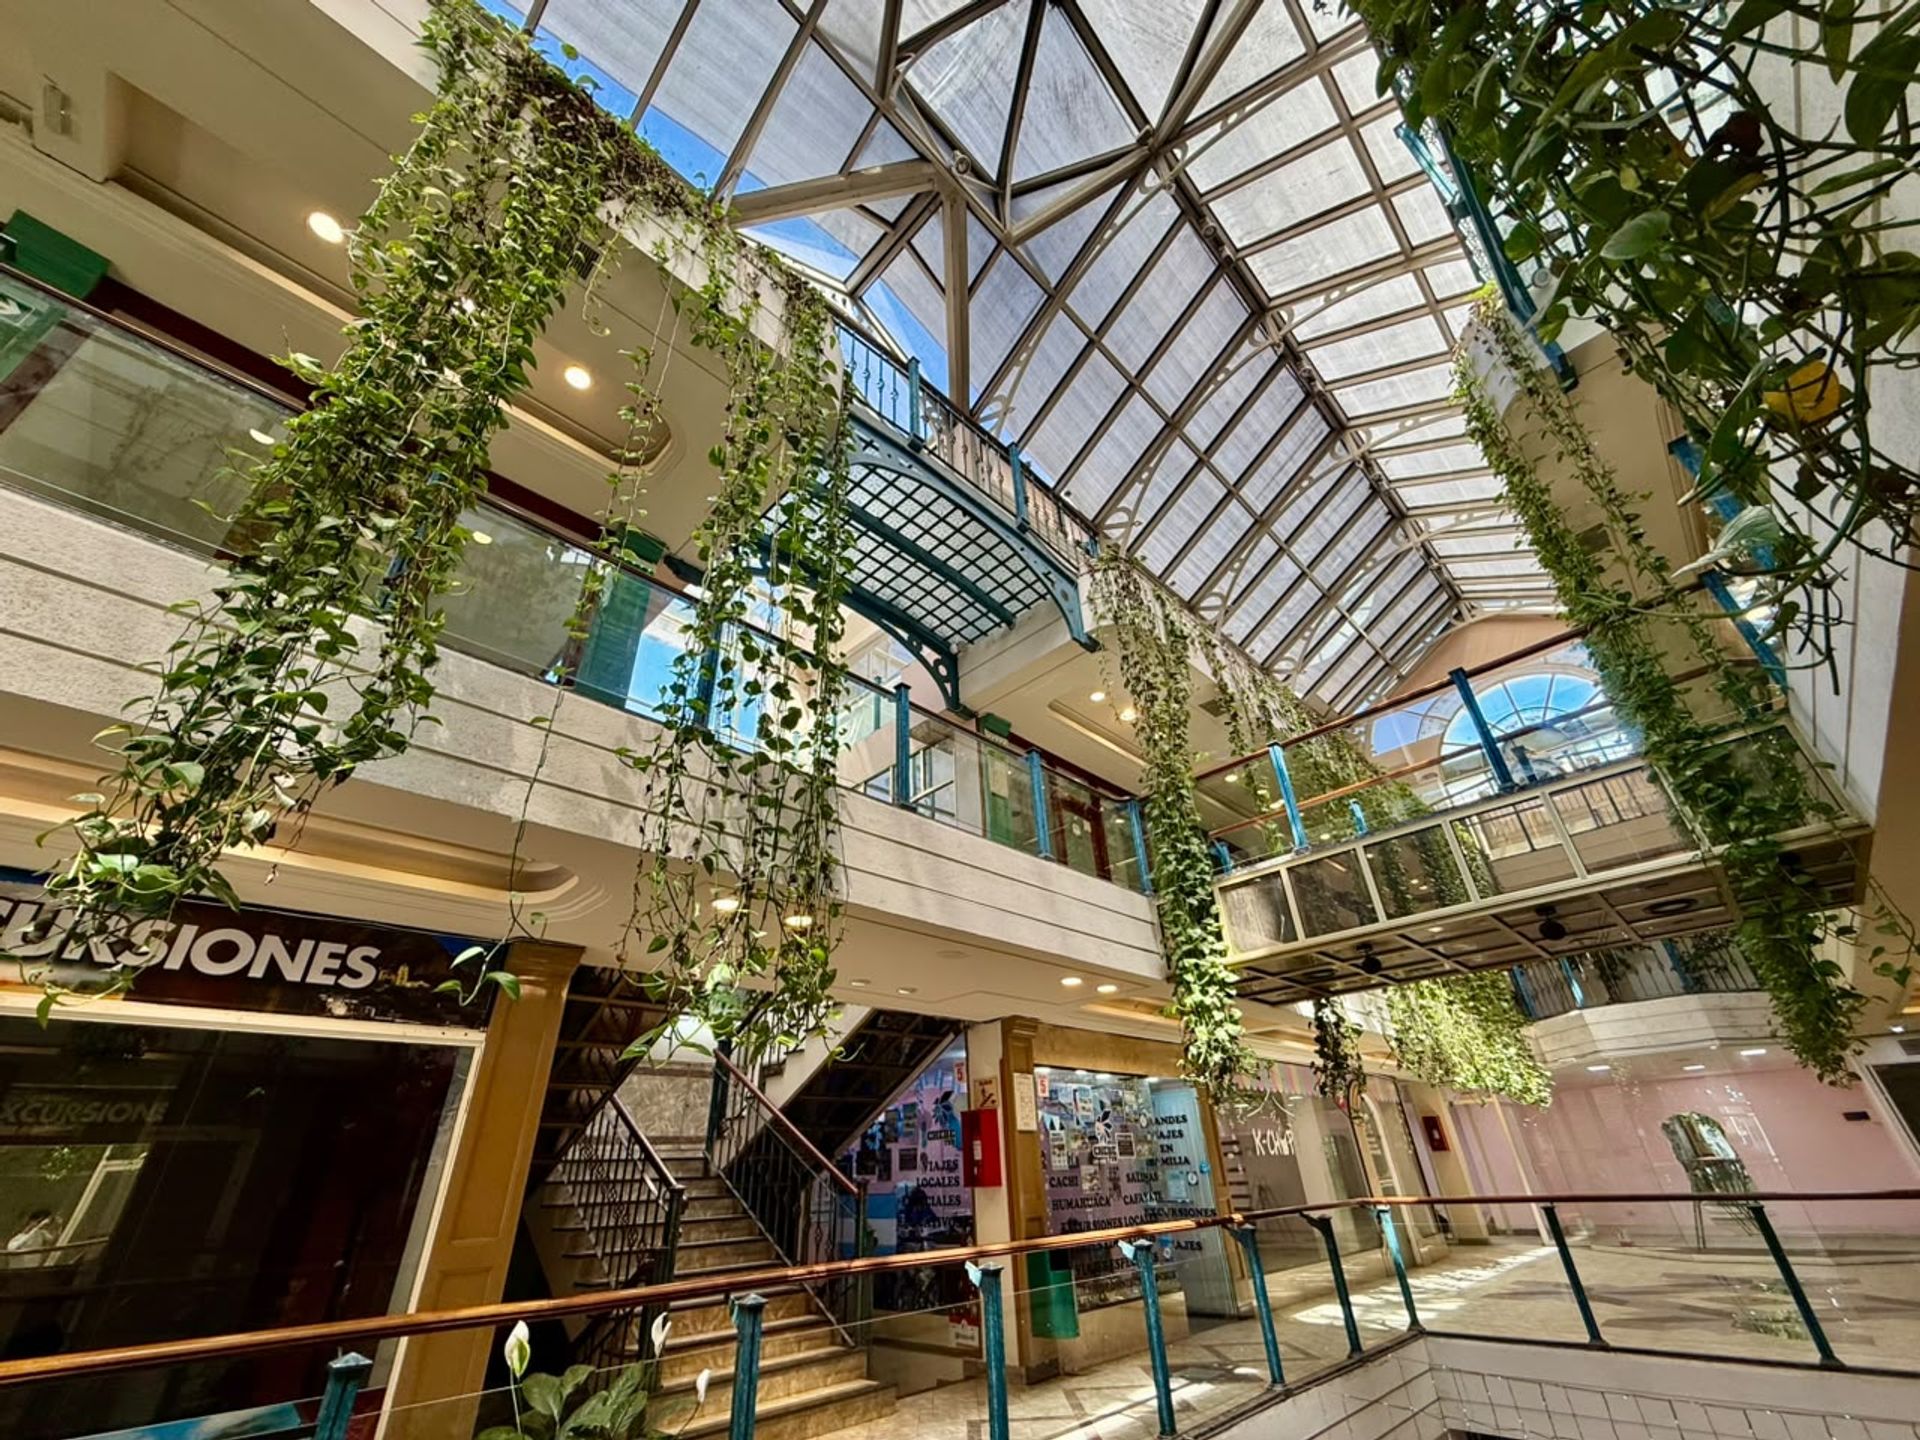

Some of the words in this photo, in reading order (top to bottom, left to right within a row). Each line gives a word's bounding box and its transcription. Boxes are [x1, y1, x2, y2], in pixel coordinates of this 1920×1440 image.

[1153, 1114, 1188, 1125] ANDES
[1155, 1129, 1184, 1140] AJES
[1160, 1143, 1174, 1154] EN
[921, 1158, 959, 1174] VIAJES
[915, 1175, 961, 1188] LOCALES
[1048, 1175, 1079, 1188] CACHI
[1051, 1194, 1112, 1212] HUMAHUACA
[1143, 1206, 1217, 1219] EXCURSIONES
